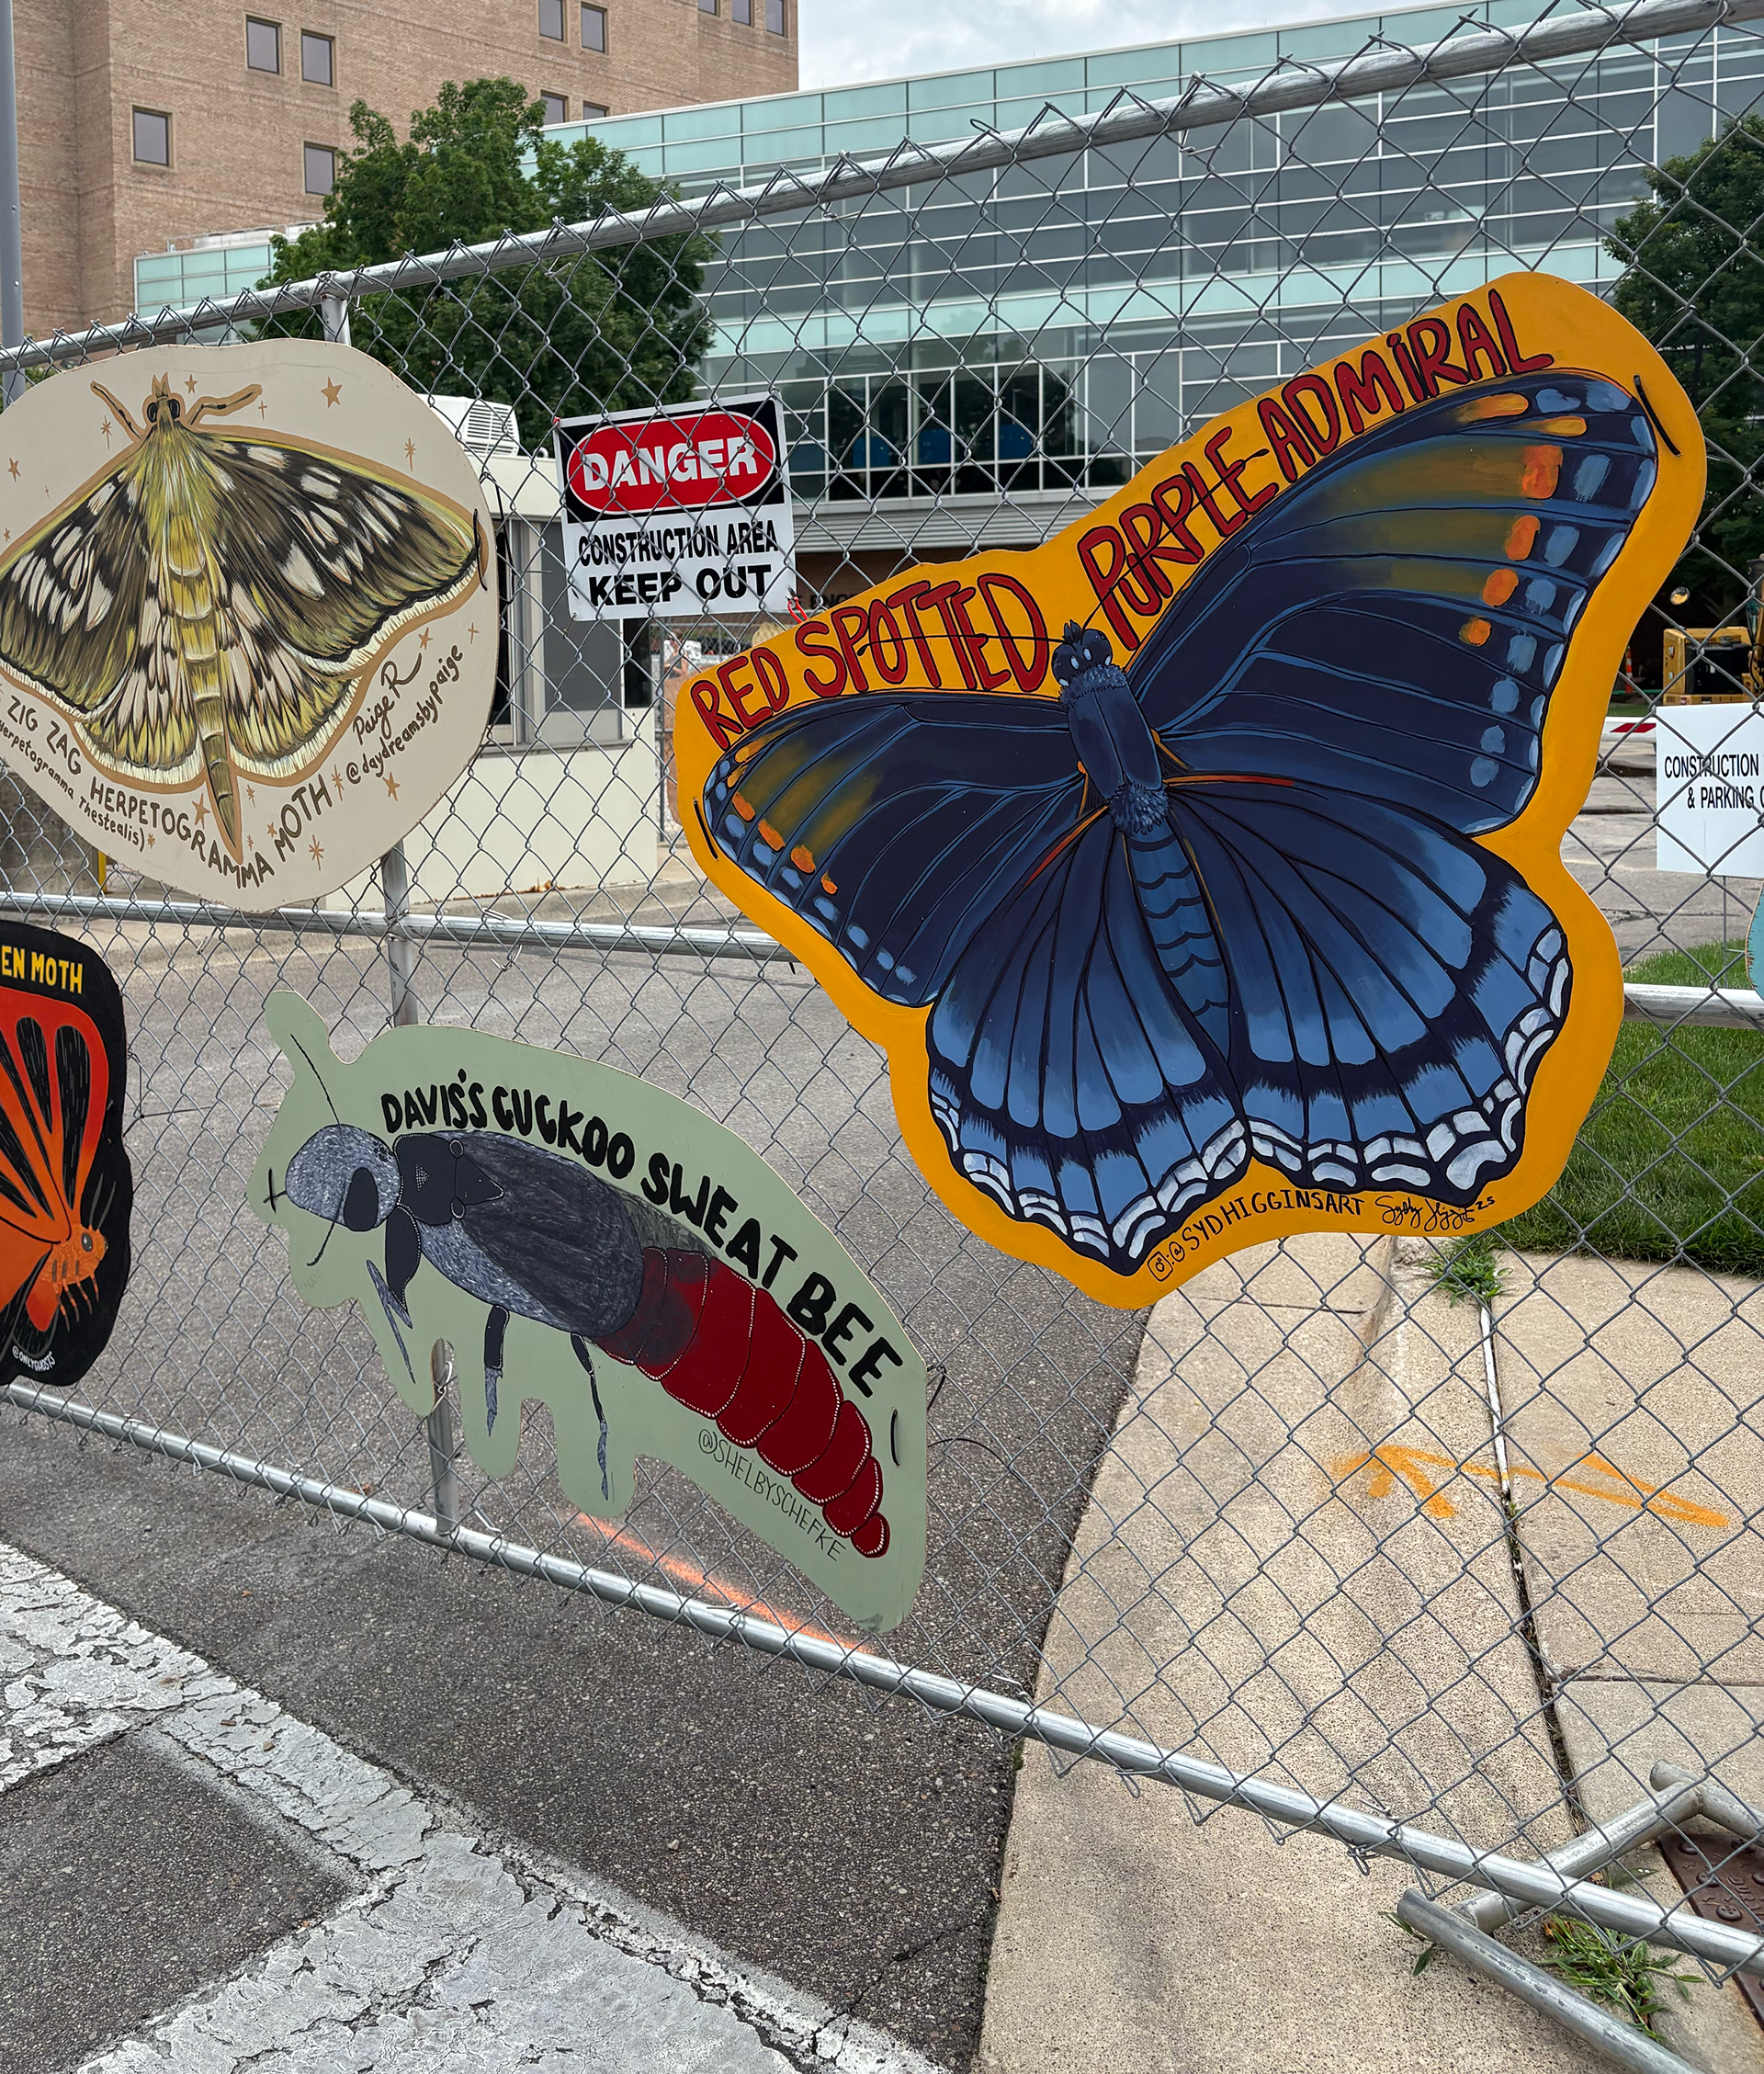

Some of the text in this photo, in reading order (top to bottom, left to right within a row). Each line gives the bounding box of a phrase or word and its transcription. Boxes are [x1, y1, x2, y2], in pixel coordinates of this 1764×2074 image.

[582, 436, 758, 492] DANGER
[578, 519, 779, 567] CONSTRUCTION AREA
[589, 564, 772, 607] KEEP OUT
[690, 646, 790, 751] RED
[795, 572, 1050, 698] SPOTTED
[1077, 425, 1279, 651] PURPLE
[346, 645, 463, 784] @daydreamsbypaige
[353, 652, 423, 745] Paige R
[7, 696, 332, 889] ZIG ZAG HERPETOGRAMMA MOTH
[1664, 754, 1758, 777] CONSTRUCTION
[1688, 786, 1695, 809] &
[1701, 786, 1754, 809] PARKING
[31, 951, 83, 994] MOTH
[380, 1069, 904, 1399] DAVIS'S CUCKOO SWEAT BEE
[698, 1429, 846, 1561] @SHELBYSCHEFKE
